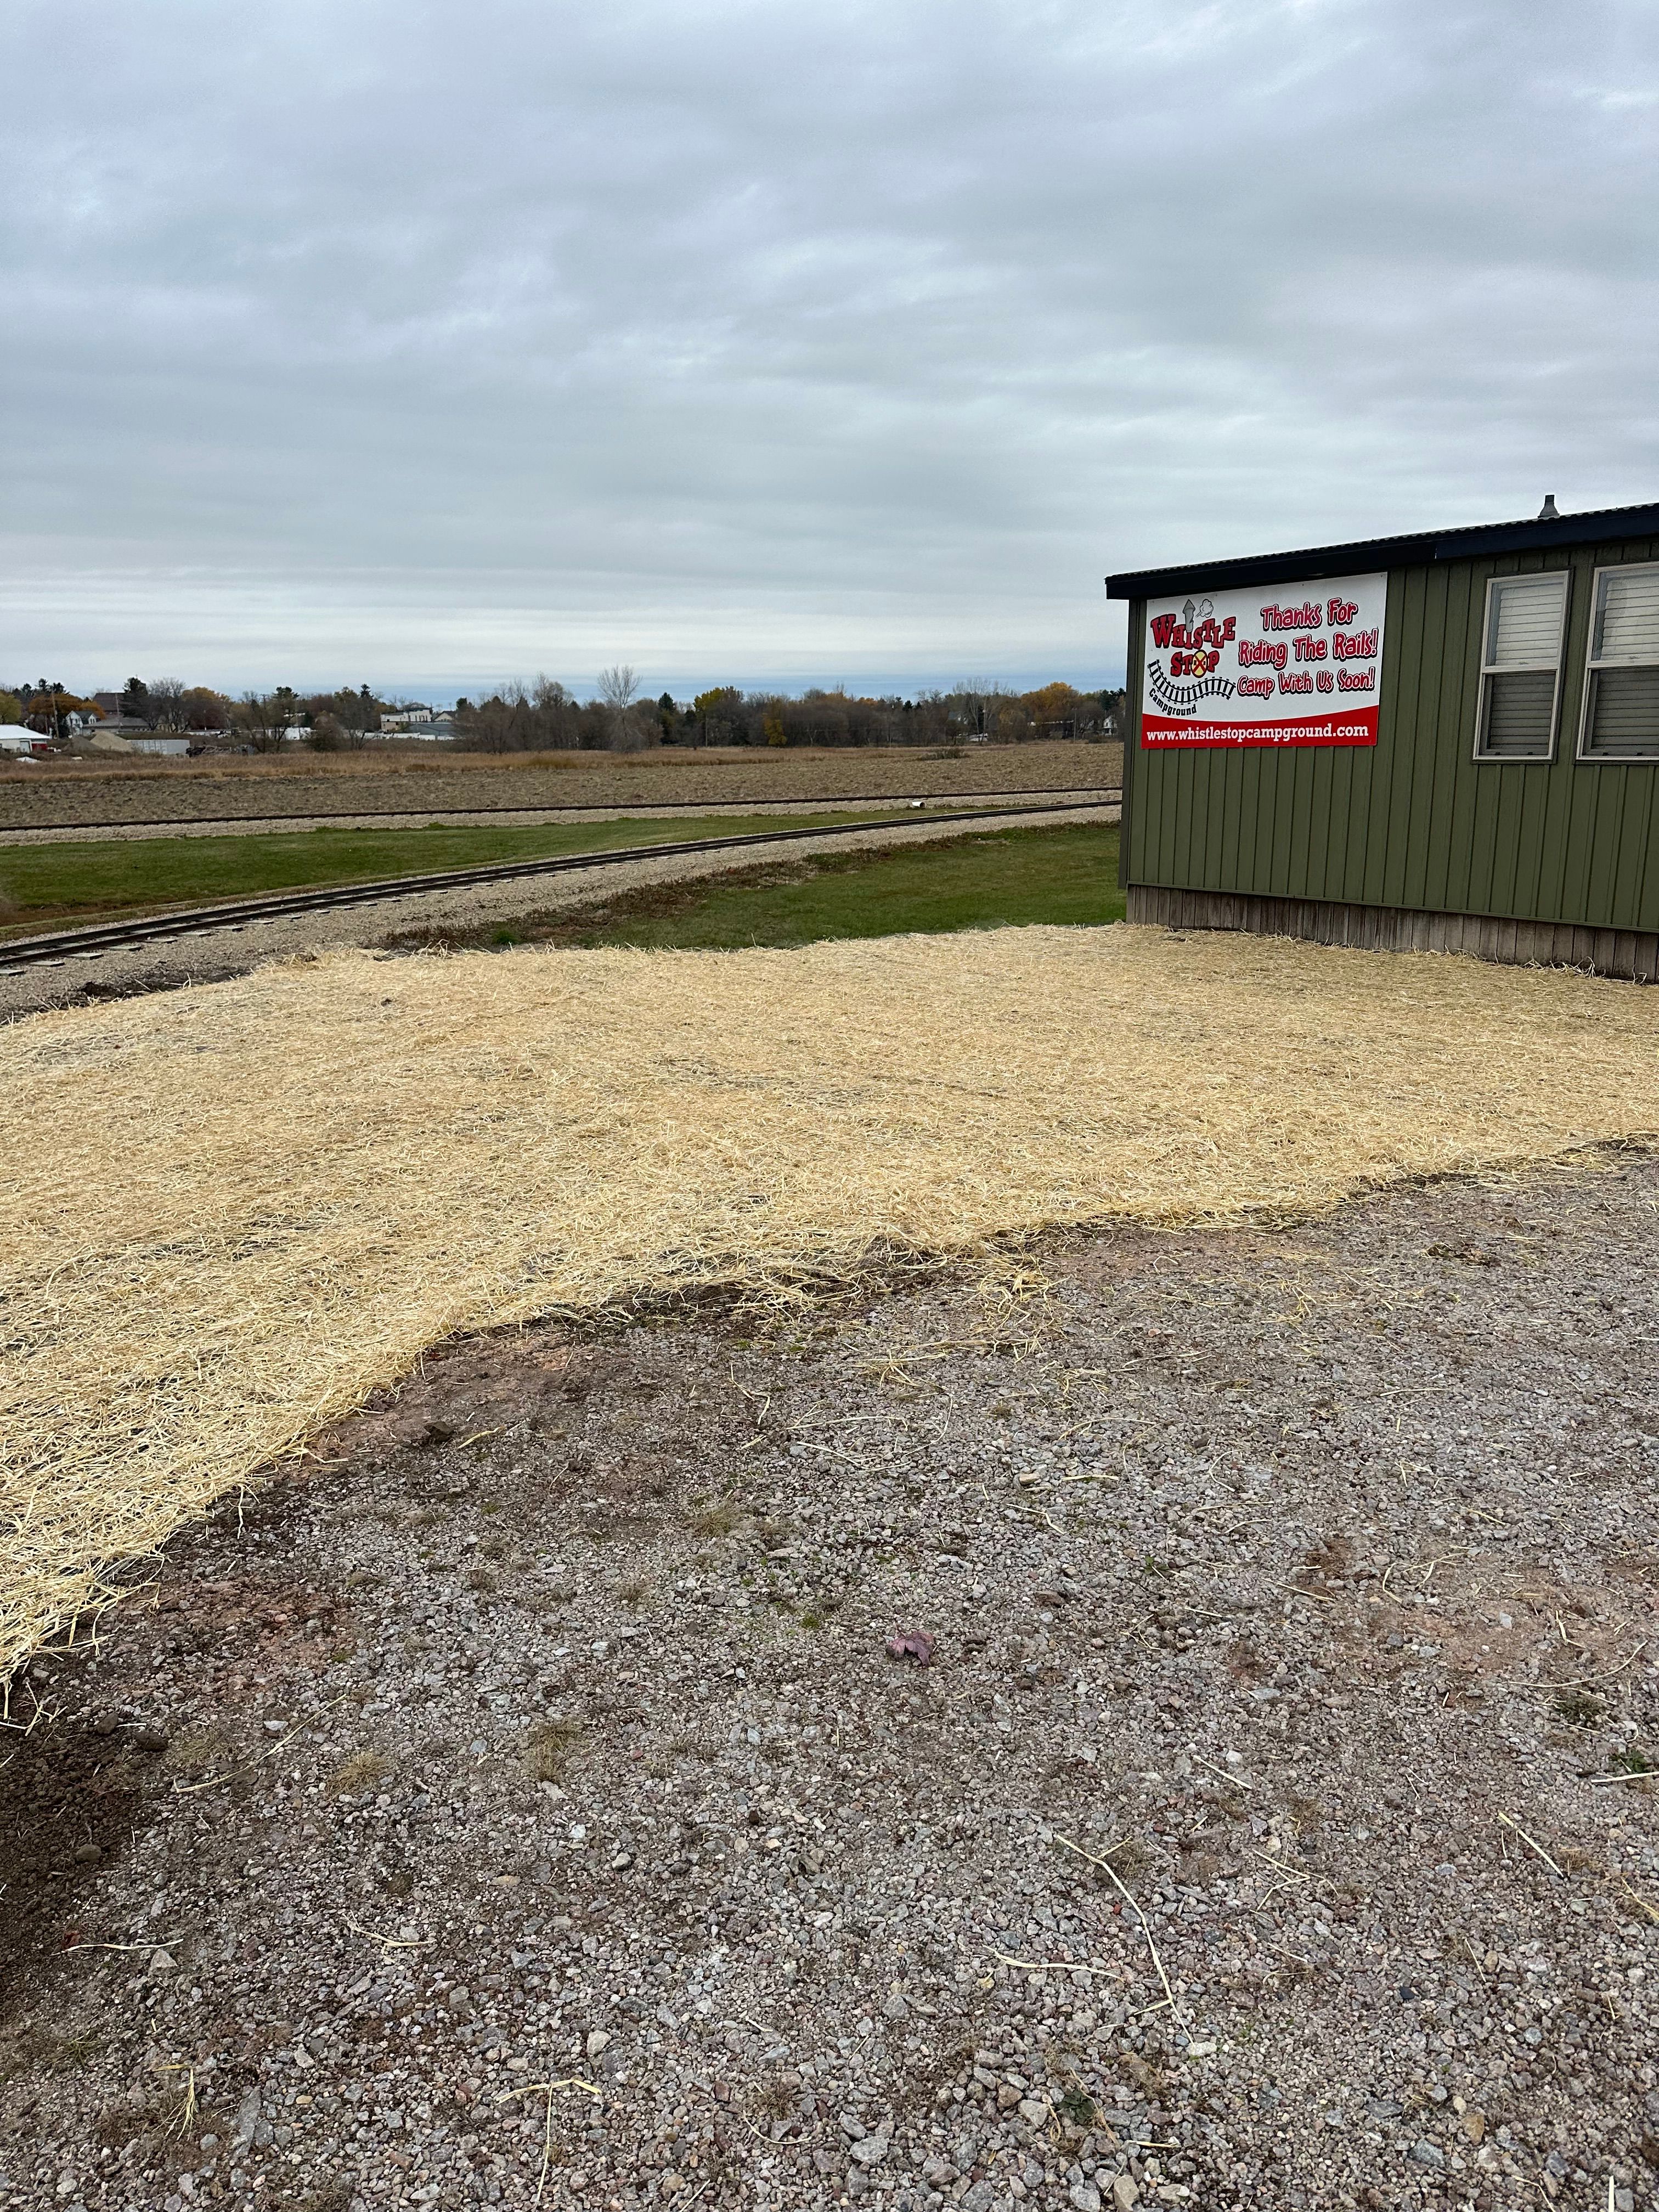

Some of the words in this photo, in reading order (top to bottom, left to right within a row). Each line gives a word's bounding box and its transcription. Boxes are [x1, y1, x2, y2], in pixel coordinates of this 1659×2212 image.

[1261, 602, 1322, 631] Thanks
[1328, 597, 1358, 626] For
[1170, 650, 1220, 678] STOP
[1239, 640, 1288, 670] Riding
[1293, 634, 1328, 662] The
[1333, 628, 1379, 662] Rails!
[1237, 675, 1275, 699] Camp
[1278, 670, 1313, 695] With
[1317, 670, 1333, 693] Us
[1337, 666, 1376, 692] Soon!
[1149, 688, 1197, 716] Campground
[1147, 723, 1369, 742] www.whistlestopcampground.com
